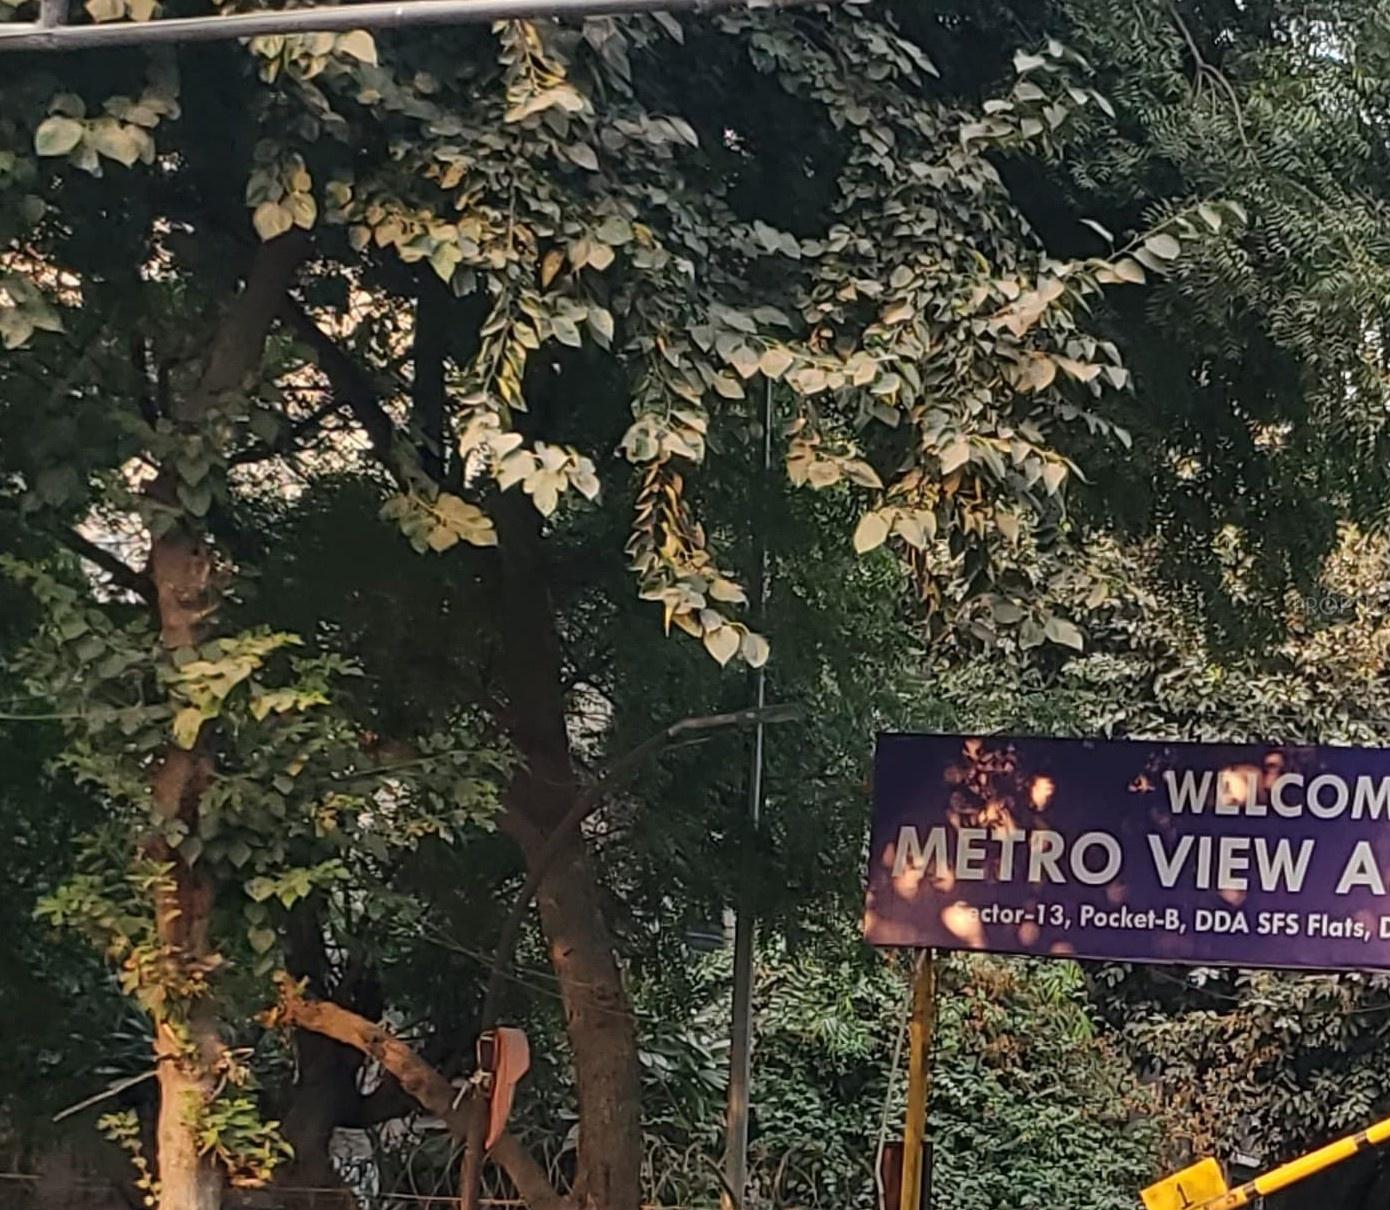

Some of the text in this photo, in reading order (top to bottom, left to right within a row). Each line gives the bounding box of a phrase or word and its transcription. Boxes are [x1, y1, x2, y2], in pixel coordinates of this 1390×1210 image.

[892, 826, 1122, 886] METRO
[1147, 834, 1315, 893] VIEW
[956, 901, 1071, 930] ector-13,
[1081, 905, 1185, 934] Pocket-B,
[1196, 911, 1249, 934] DDA
[1257, 912, 1299, 935] SFS
[1307, 913, 1371, 940] Flats,
